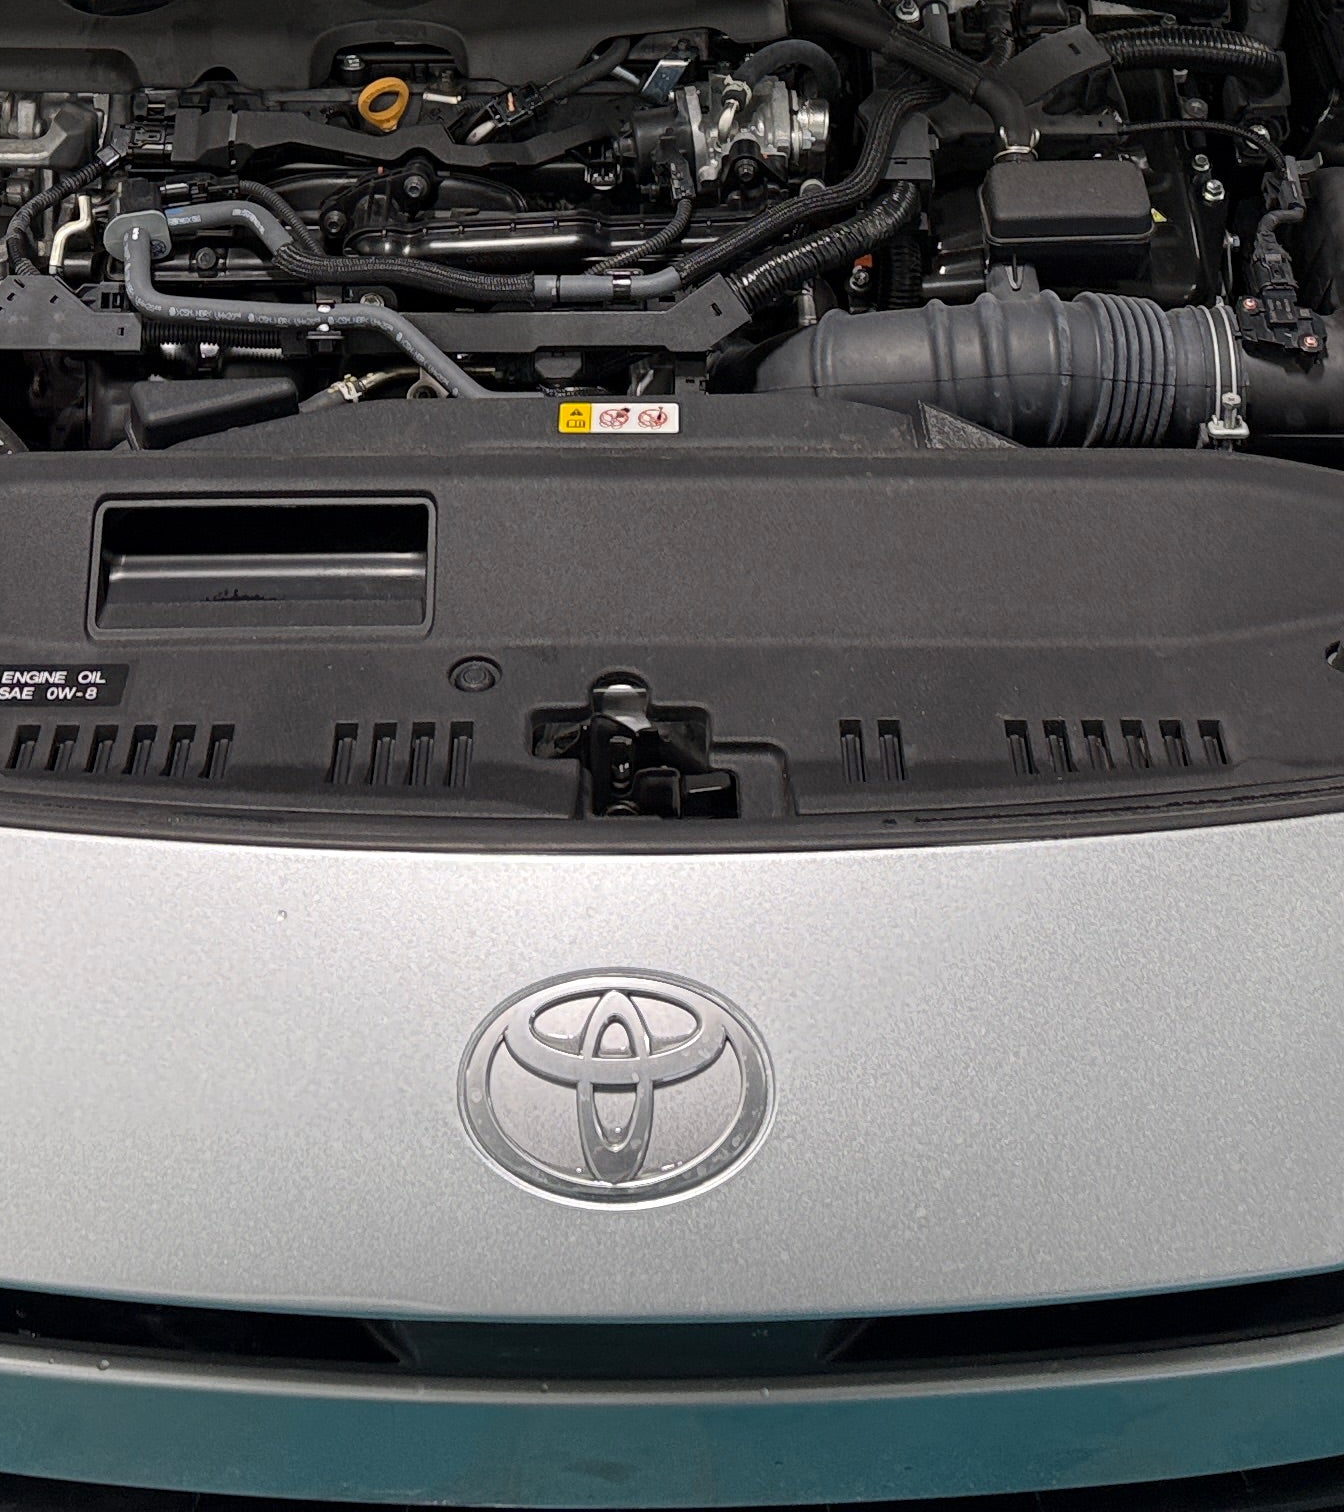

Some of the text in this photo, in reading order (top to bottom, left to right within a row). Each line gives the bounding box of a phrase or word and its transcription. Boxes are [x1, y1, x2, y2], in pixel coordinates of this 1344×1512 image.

[1, 671, 106, 684] ENGINE OIL
[46, 687, 97, 700] 0W-8
